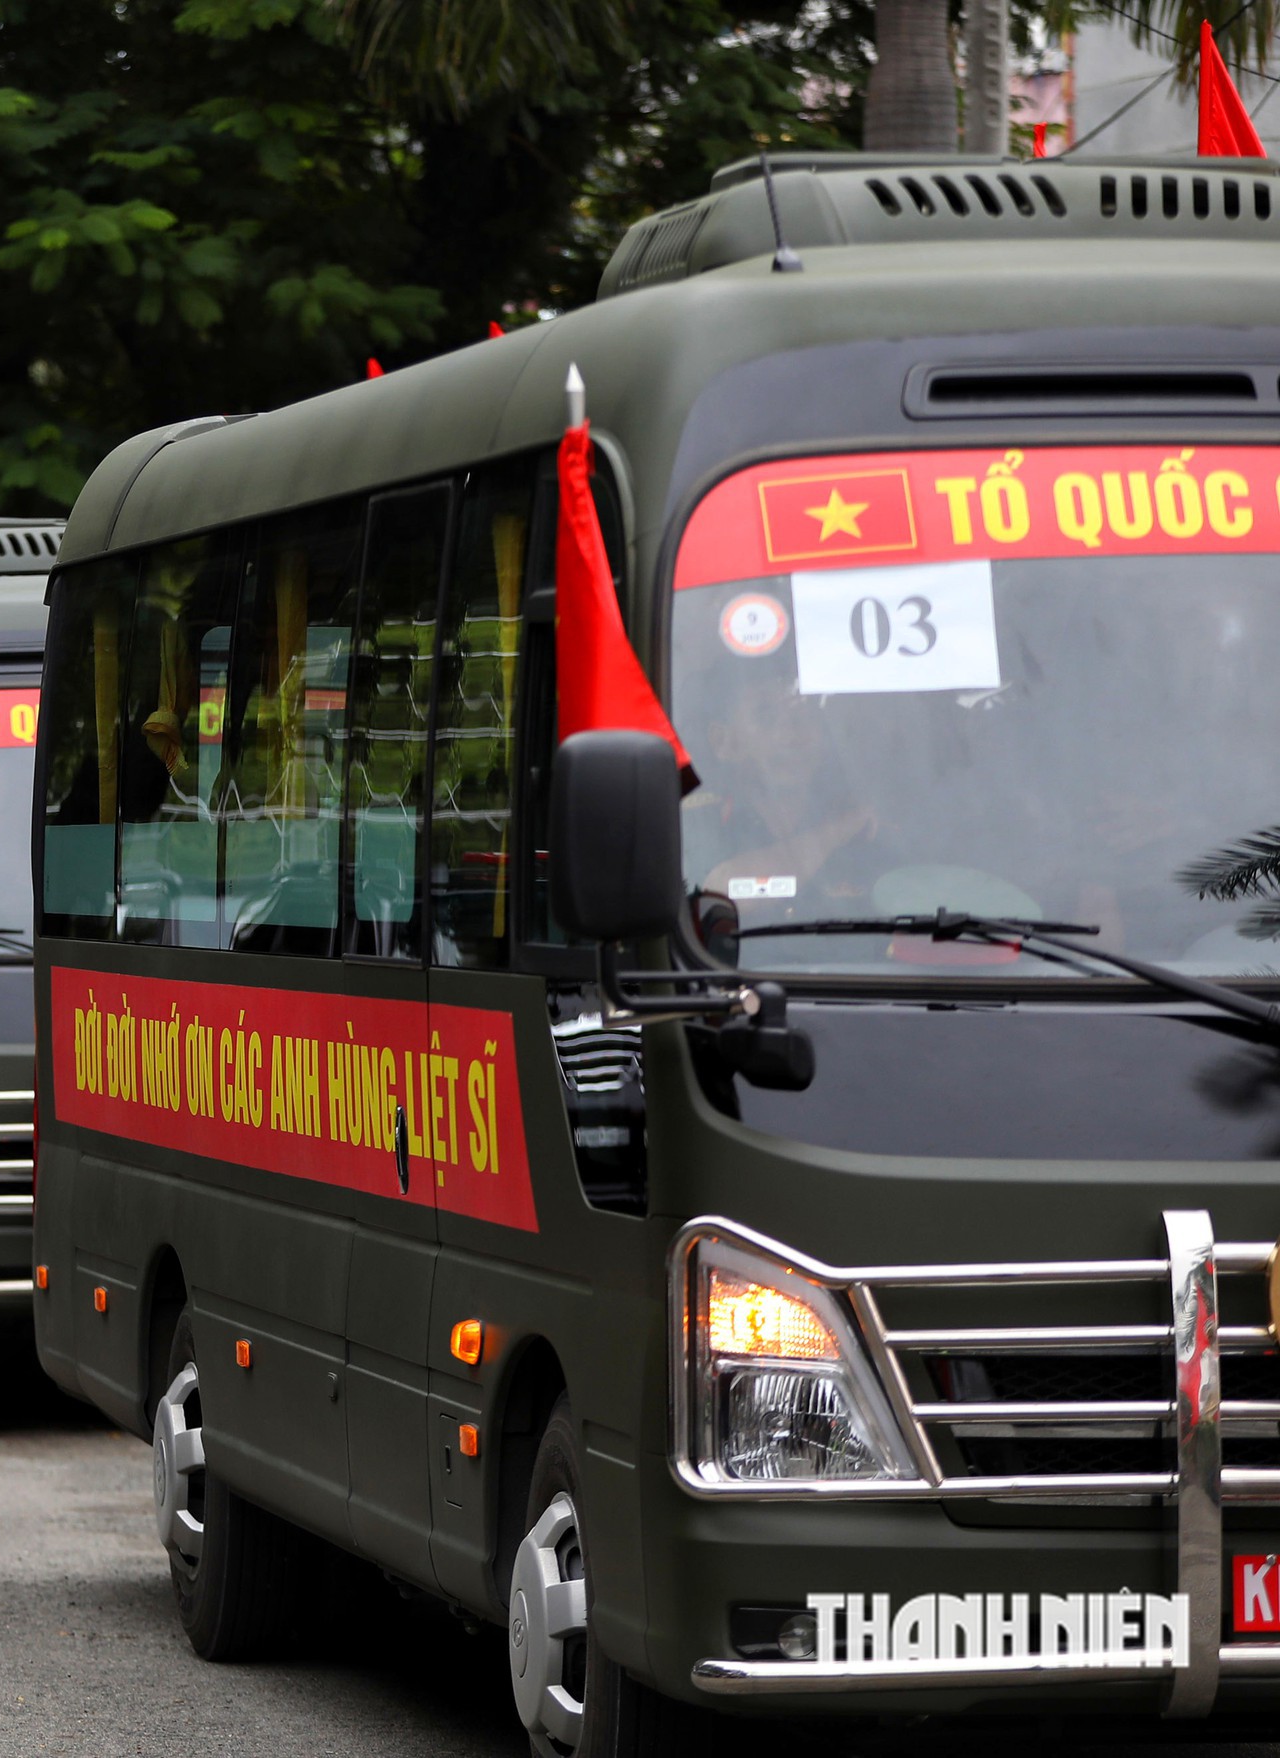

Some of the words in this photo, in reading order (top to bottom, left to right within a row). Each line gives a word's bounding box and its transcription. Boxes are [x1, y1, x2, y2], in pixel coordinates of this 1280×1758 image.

[935, 449, 1031, 545] TỔ
[1053, 448, 1254, 548] QUỐC
[849, 595, 938, 658] 03
[10, 703, 40, 743] Q
[75, 988, 103, 1095] ĐỜI
[107, 993, 138, 1103] ĐỜI
[141, 1002, 180, 1112] NHỚ
[185, 1015, 215, 1118] ƠN
[220, 1009, 263, 1128] CÁC
[270, 1034, 322, 1138] ANH
[326, 1020, 398, 1153] HÙNG
[404, 1030, 459, 1188] LIỆT
[467, 1039, 499, 1175] SĨ
[1243, 1563, 1280, 1622] K
